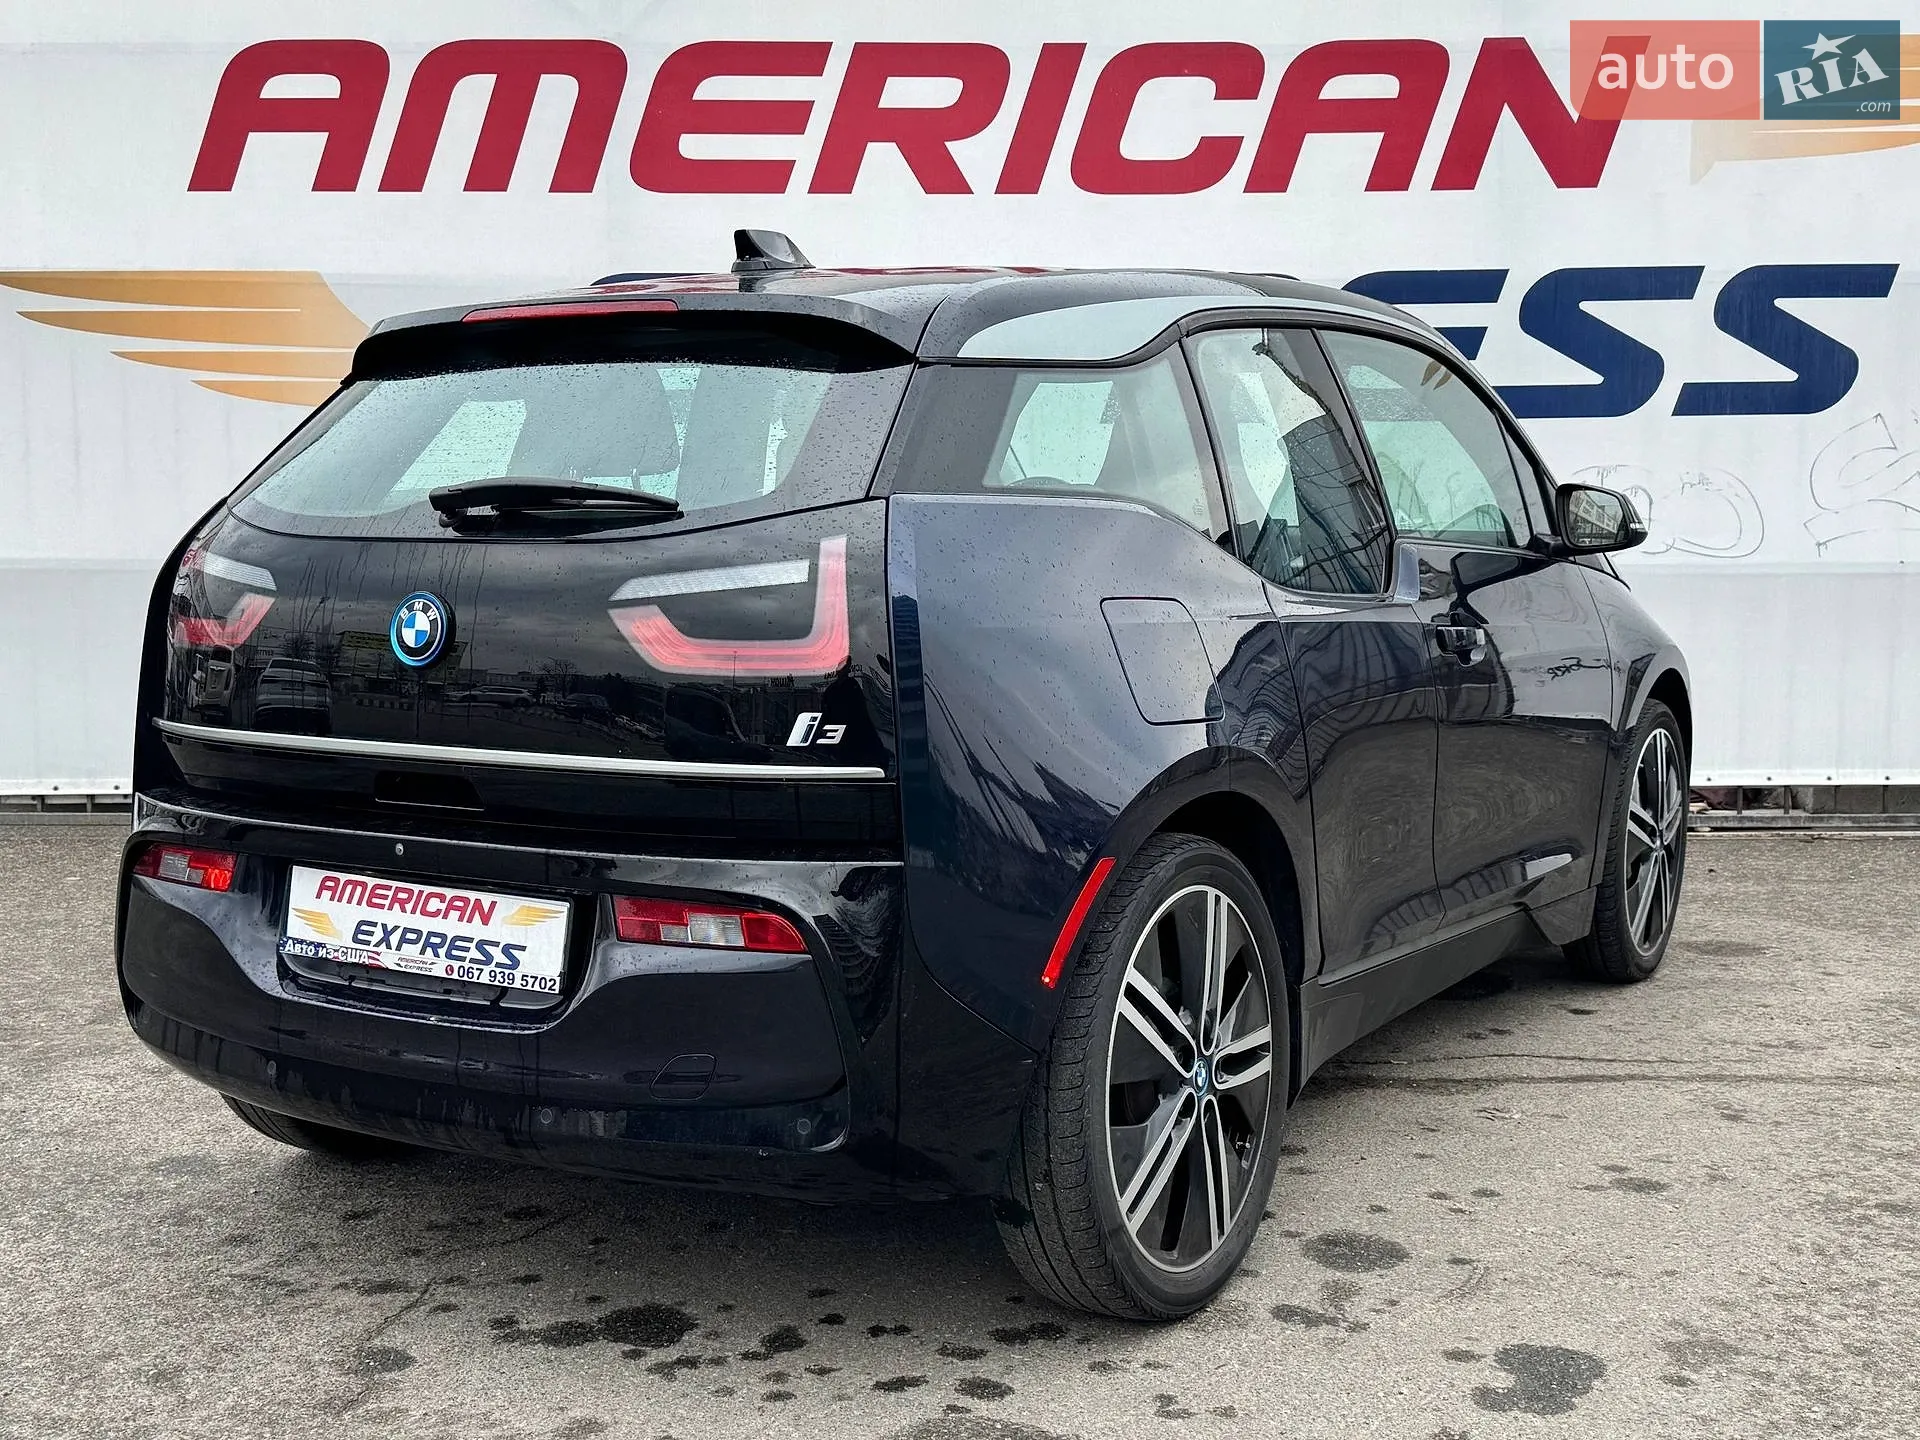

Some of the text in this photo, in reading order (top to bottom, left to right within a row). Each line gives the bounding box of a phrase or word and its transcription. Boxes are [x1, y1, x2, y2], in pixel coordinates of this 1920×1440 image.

[188, 36, 1651, 195] AMERICAN
[400, 601, 438, 621] BMW
[786, 712, 847, 747] i3
[315, 875, 497, 926] AMERICAN
[284, 939, 370, 965] Авто из США
[351, 919, 528, 972] EXPRESS
[397, 956, 429, 966] AMERICAN
[403, 963, 434, 973] EXPRESS
[457, 965, 557, 992] 067 939 5702
